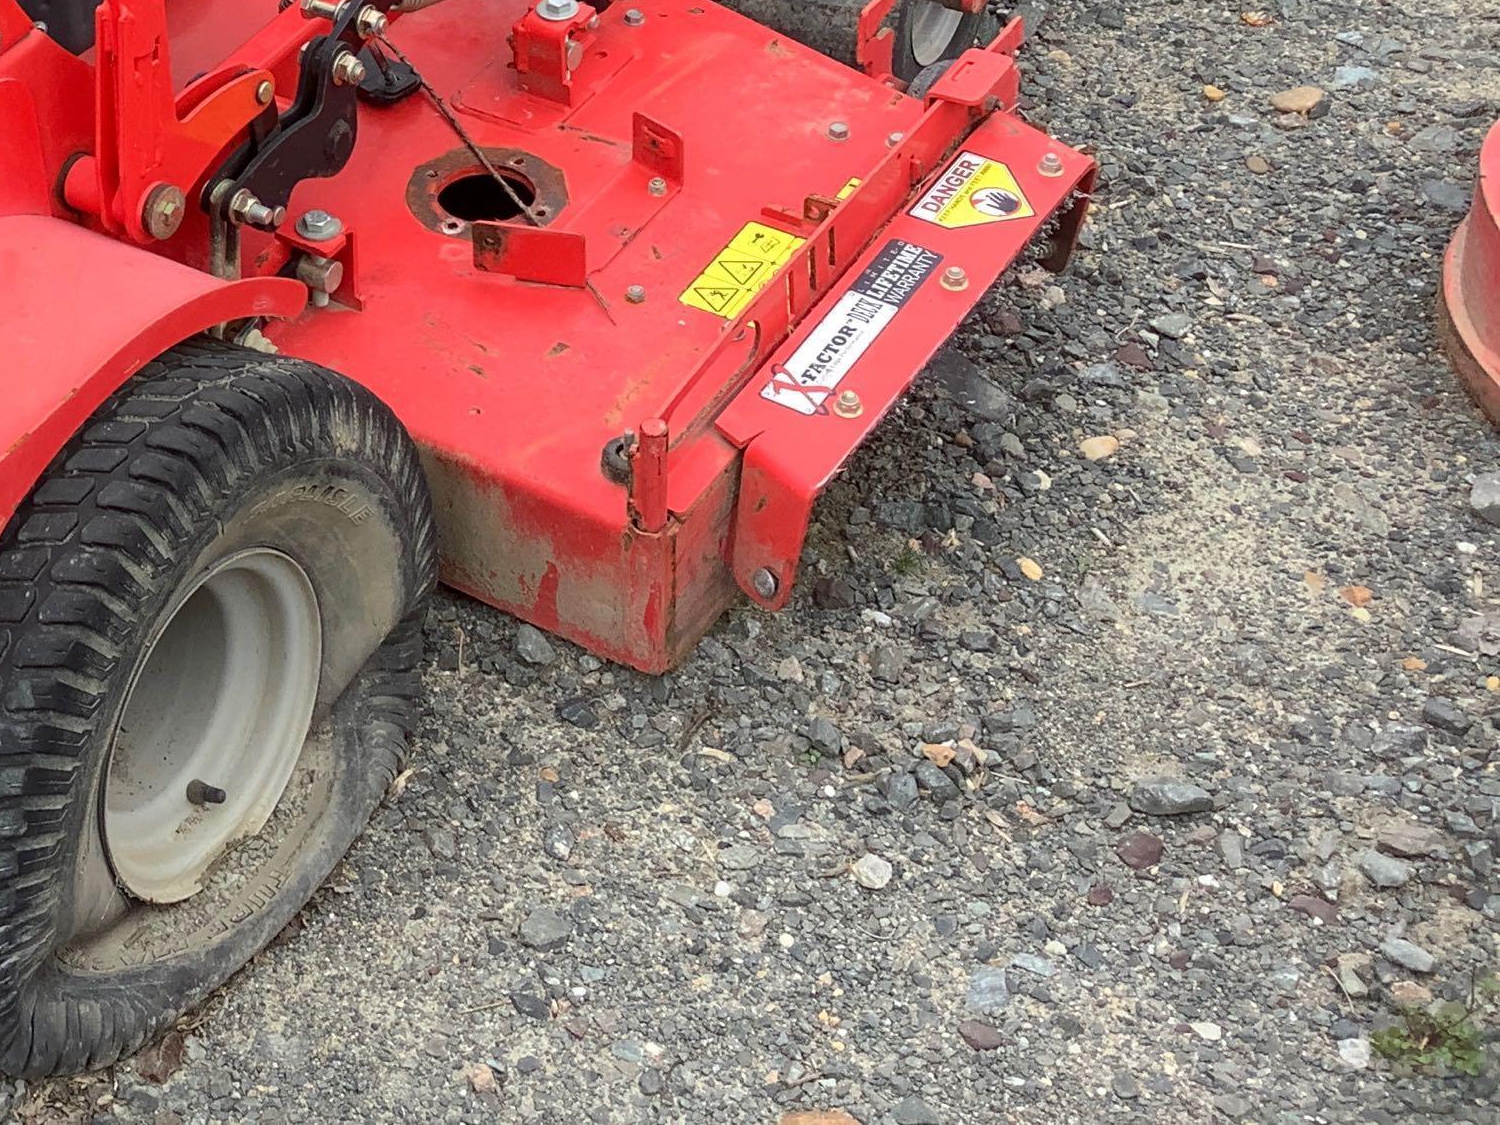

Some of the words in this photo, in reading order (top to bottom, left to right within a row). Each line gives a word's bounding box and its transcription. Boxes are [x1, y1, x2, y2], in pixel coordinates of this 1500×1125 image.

[921, 159, 980, 213] DANGER
[866, 243, 924, 299] LIFETIME
[884, 249, 938, 305] WARRANTY
[846, 297, 884, 324] DECK
